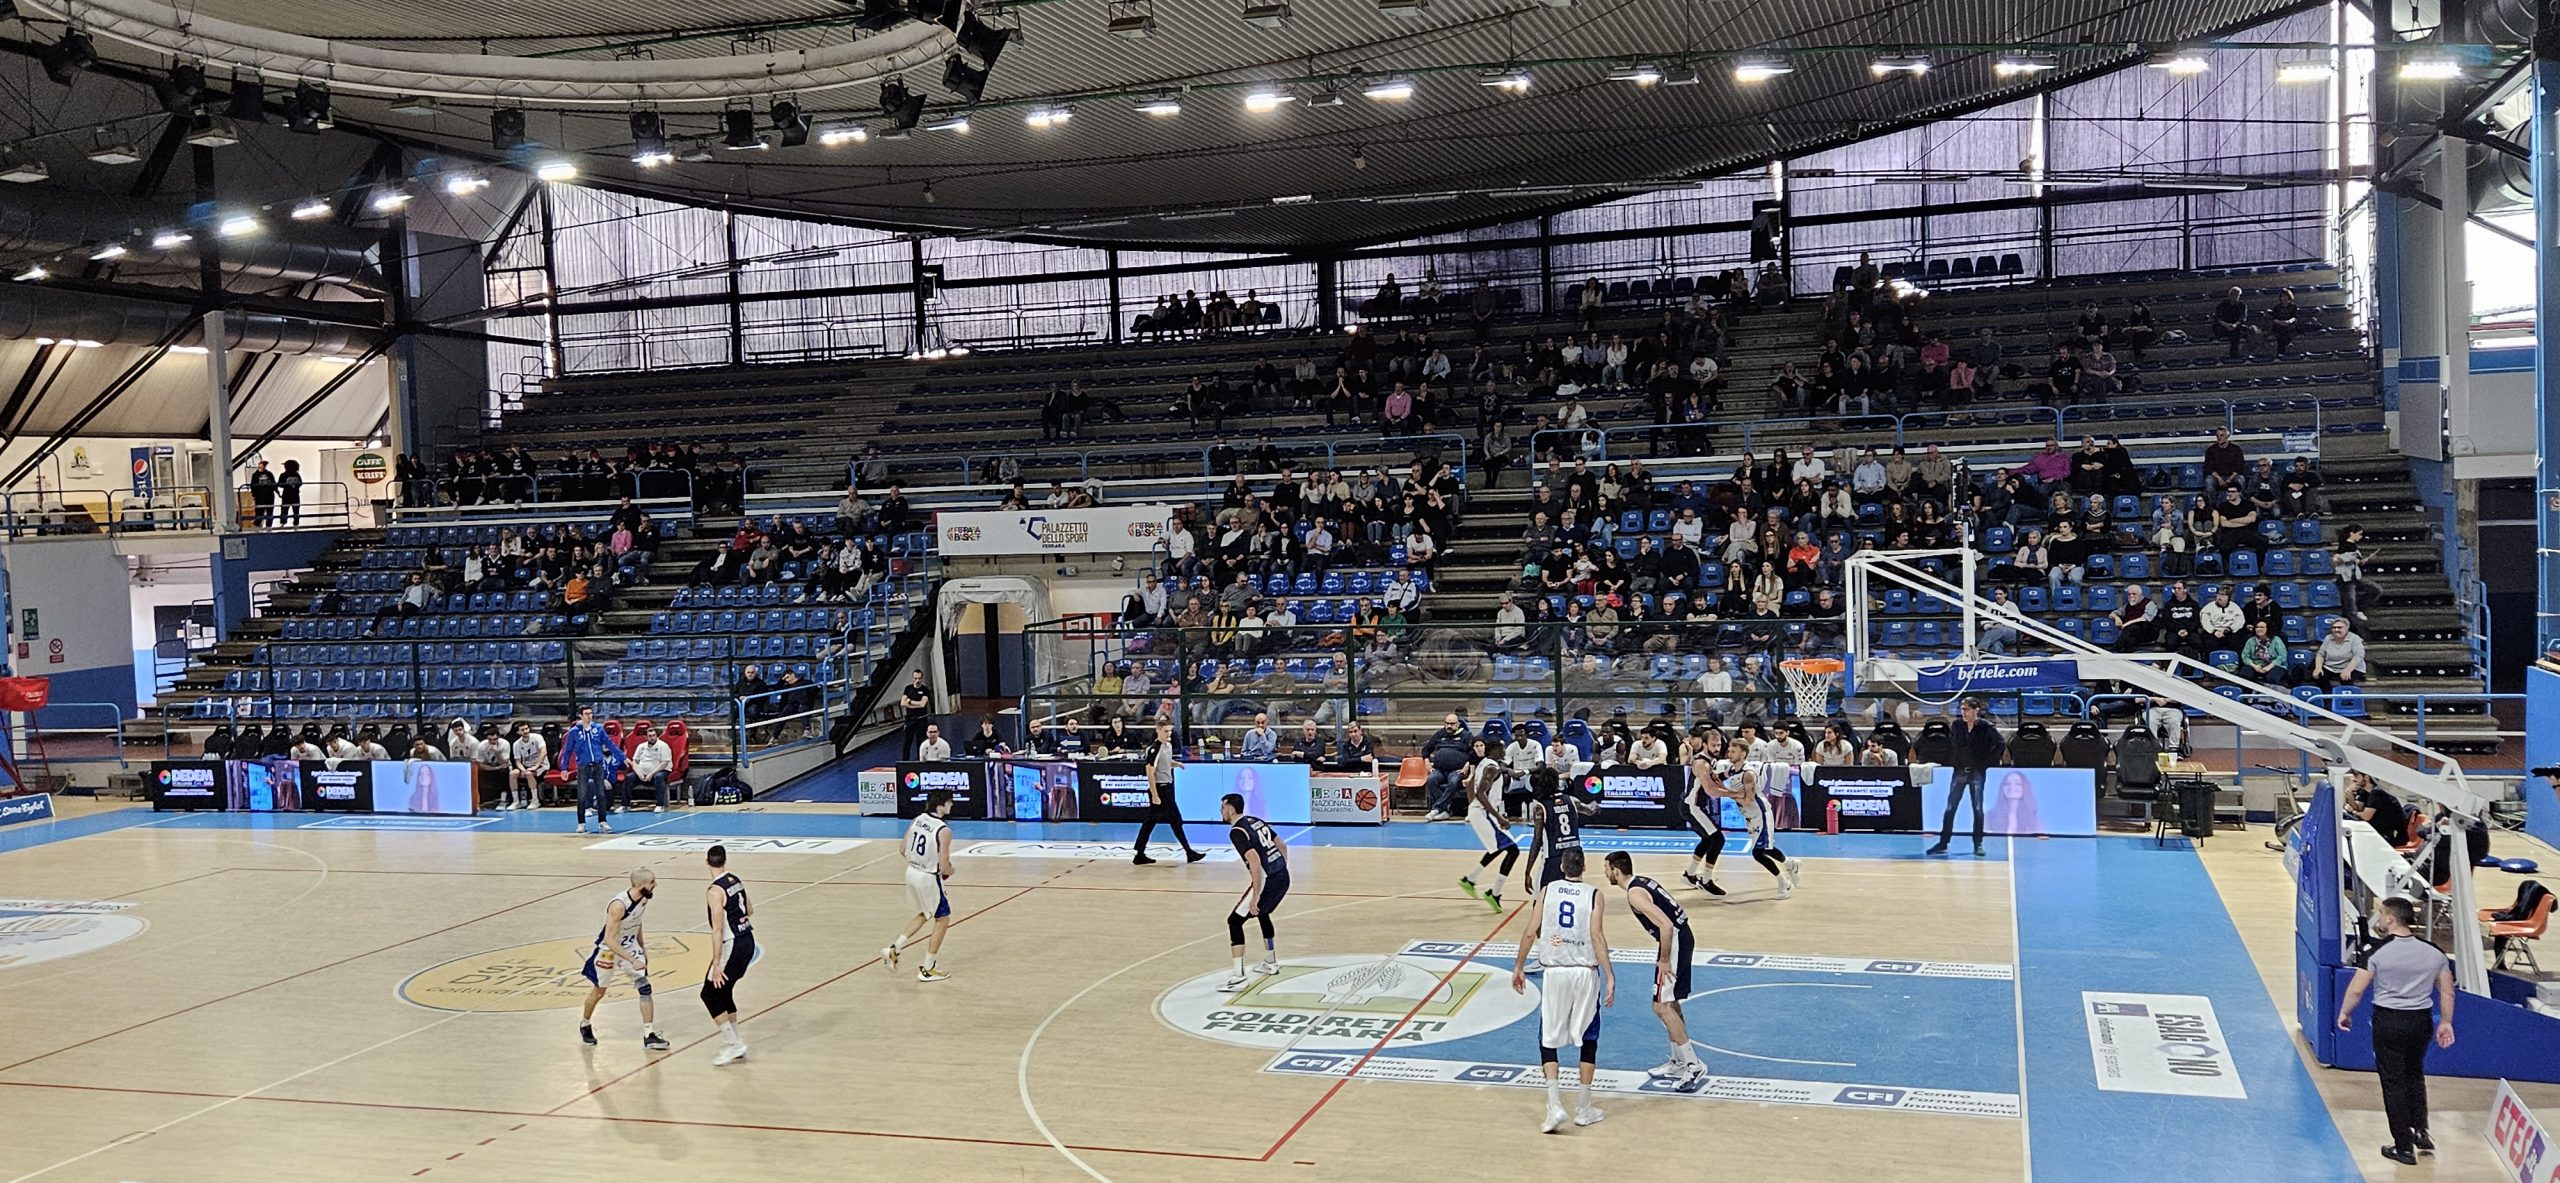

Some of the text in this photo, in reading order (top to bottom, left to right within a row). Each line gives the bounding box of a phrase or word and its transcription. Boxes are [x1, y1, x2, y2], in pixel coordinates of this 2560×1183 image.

[1041, 522, 1089, 534] PALAZZETTO
[1042, 532, 1089, 544] DELLO SPORT
[1958, 665, 2038, 680] bertele.com
[172, 769, 214, 783] DEDEM
[920, 772, 969, 785] DEDEM
[860, 782, 895, 792] LEGA
[1603, 776, 1665, 791] DEDEM
[1111, 793, 1149, 802] DEDEM
[1312, 789, 1351, 798] LEGA
[1842, 799, 1891, 811] DEDEM
[1558, 814, 1571, 836] 8
[911, 831, 927, 856] 18
[1257, 826, 1276, 849] 42
[1558, 900, 1576, 928] 8
[1206, 1011, 1448, 1032] COLDIRETTI
[1202, 1021, 1424, 1042] FERRARA
[1289, 1058, 1333, 1069] CFI
[1469, 1069, 1514, 1079] CFI
[1716, 1078, 1770, 1086] Centro
[1703, 1090, 1811, 1101] Innovazione
[1710, 1084, 1811, 1095] Formazione
[1913, 1090, 1971, 1099] Centro
[1847, 1091, 1894, 1102] CFI
[1908, 1096, 2017, 1108] Formazione
[1903, 1102, 2018, 1115] Innovazione
